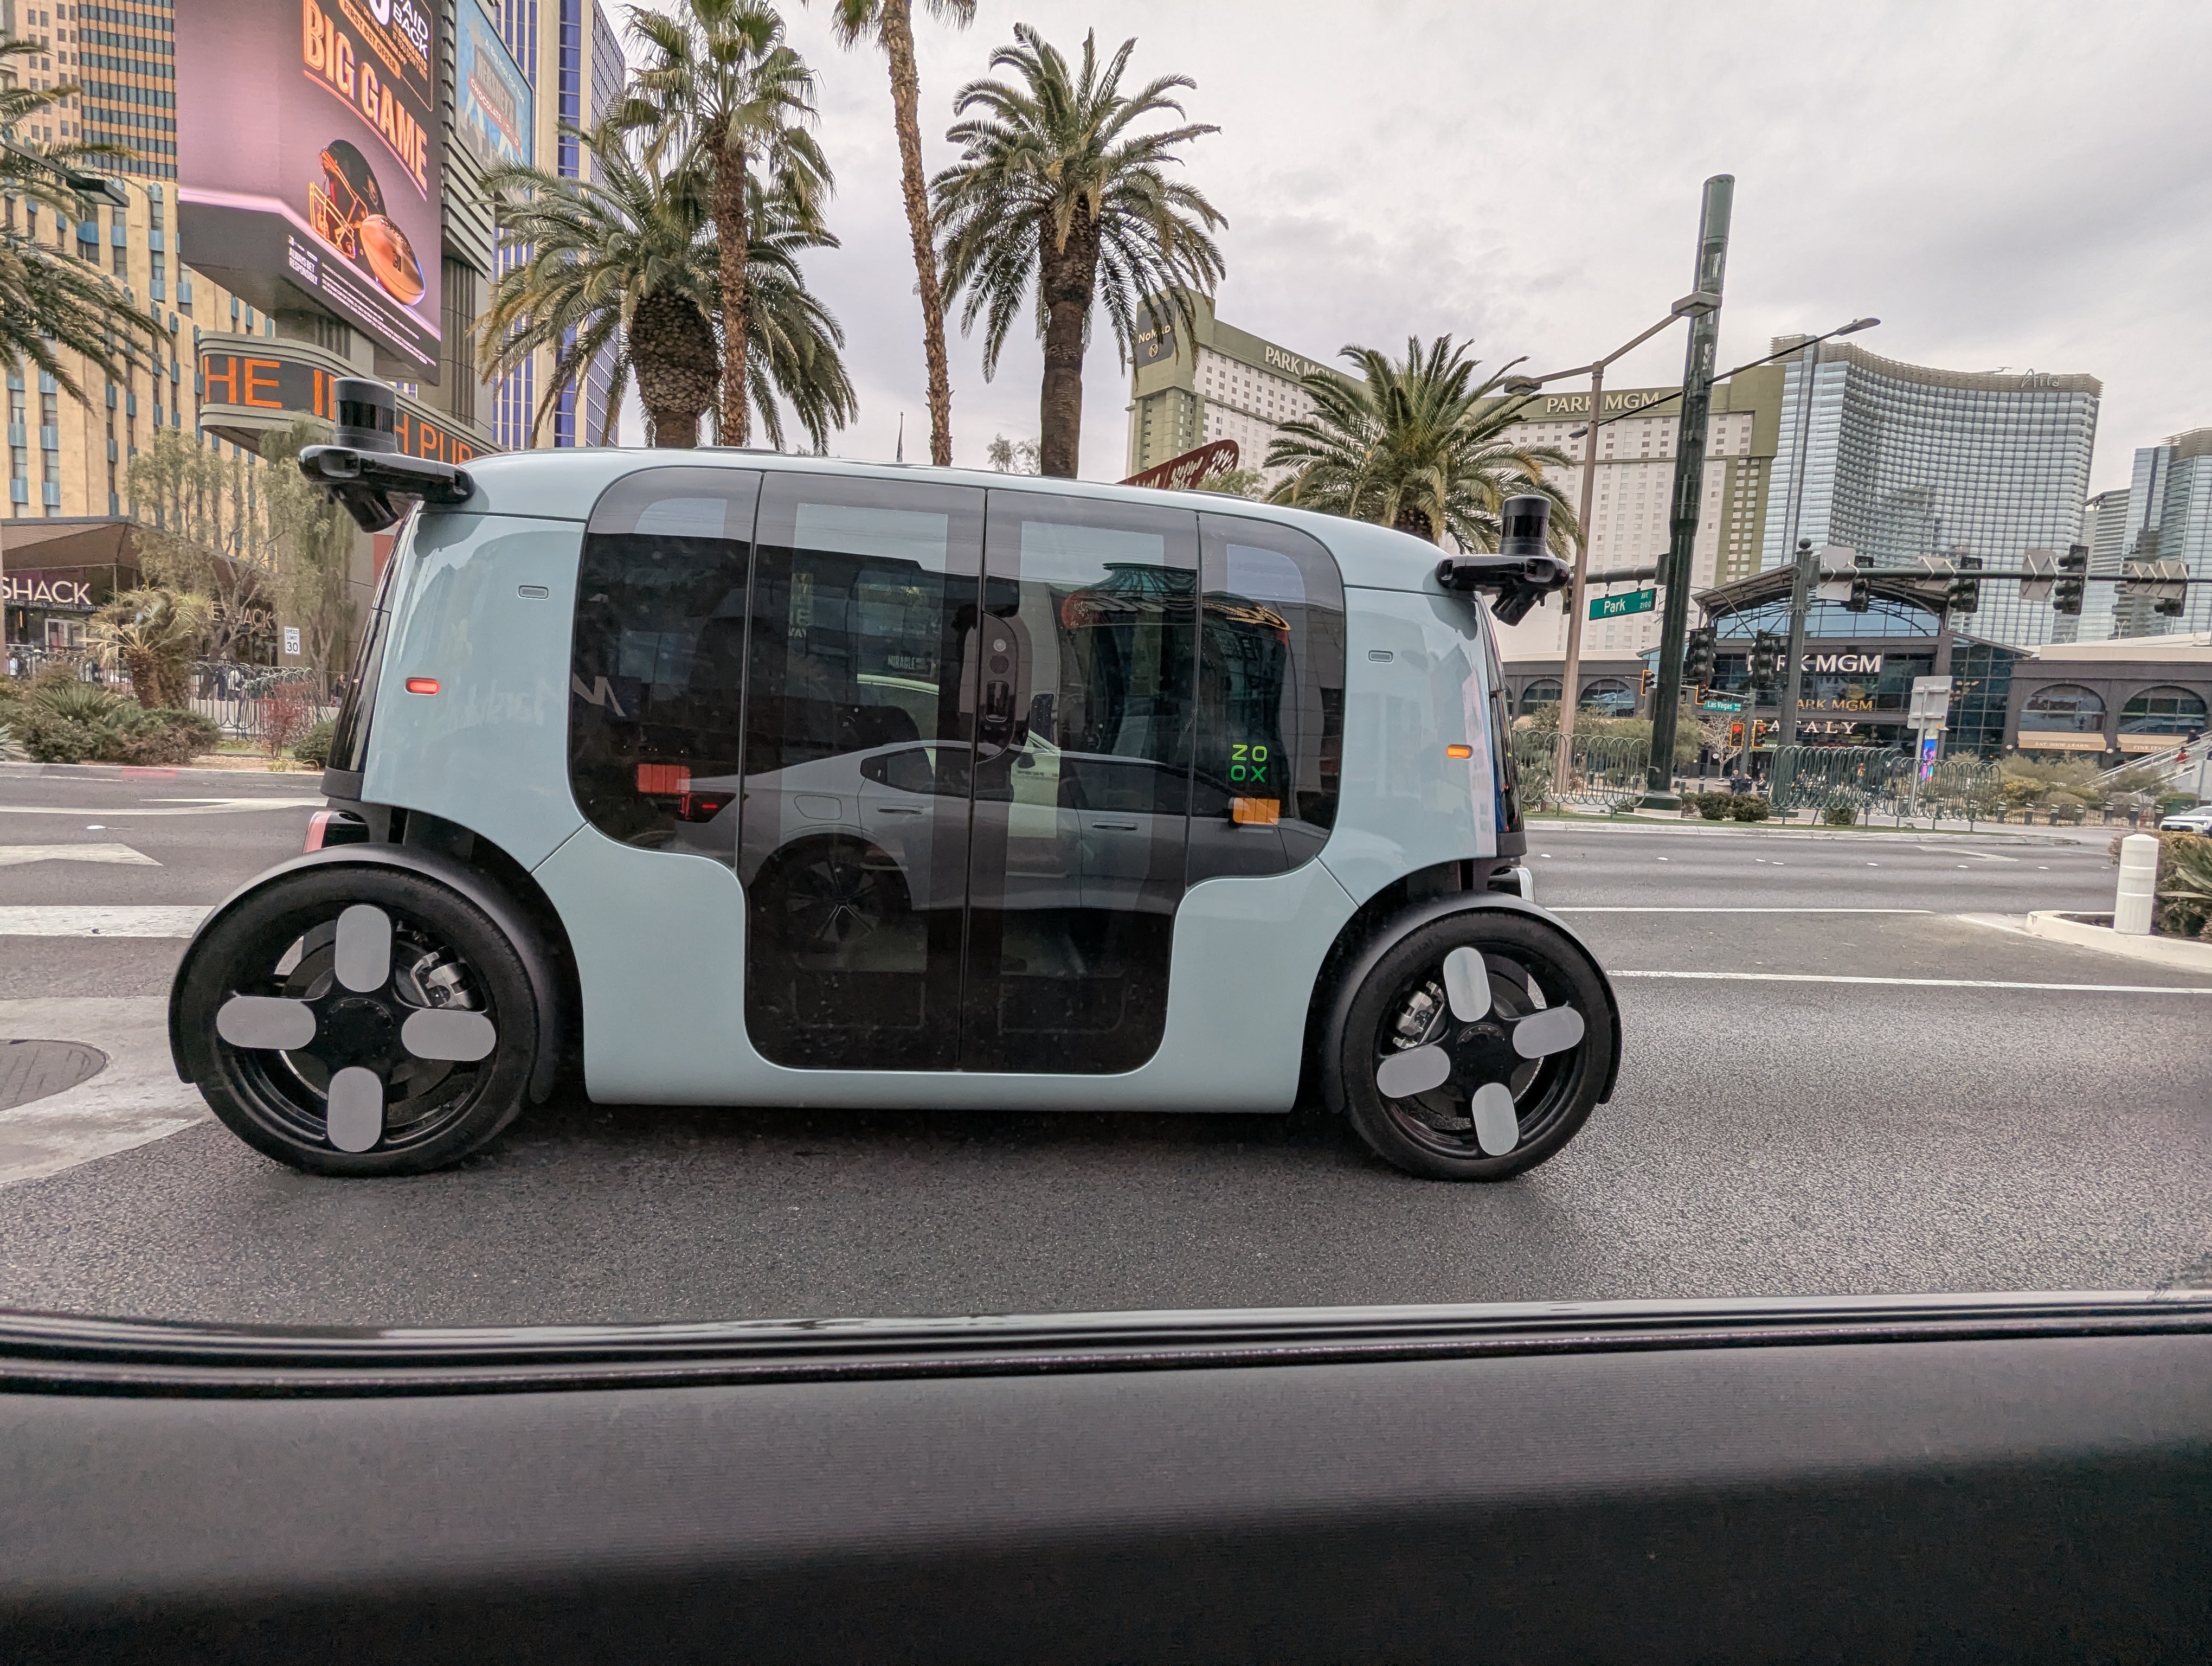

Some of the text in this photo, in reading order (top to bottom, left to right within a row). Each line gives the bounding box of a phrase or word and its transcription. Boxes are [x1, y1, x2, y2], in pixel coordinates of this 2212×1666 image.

[400, 0, 428, 40] AID
[344, 3, 363, 28] FIRST
[364, 24, 376, 45] BET
[377, 42, 396, 71] OFFER
[393, 2, 427, 60] BACK
[303, 0, 427, 191] BIG GAME
[471, 78, 501, 124] CHOCOLATE
[306, 260, 315, 273] BET
[1265, 346, 1300, 375] PARK
[1547, 392, 1660, 413] PARK MGM
[2, 576, 93, 605] SHACK
[1604, 598, 1625, 614] Park
[287, 642, 298, 652] 30
[1747, 655, 1881, 672] RK MGM
[1718, 702, 1733, 711] Vegas
[1798, 699, 1873, 712] ARK MGM
[1752, 720, 1857, 734] EAALY
[1232, 744, 1268, 762] ZO
[1231, 765, 1266, 783] OX
